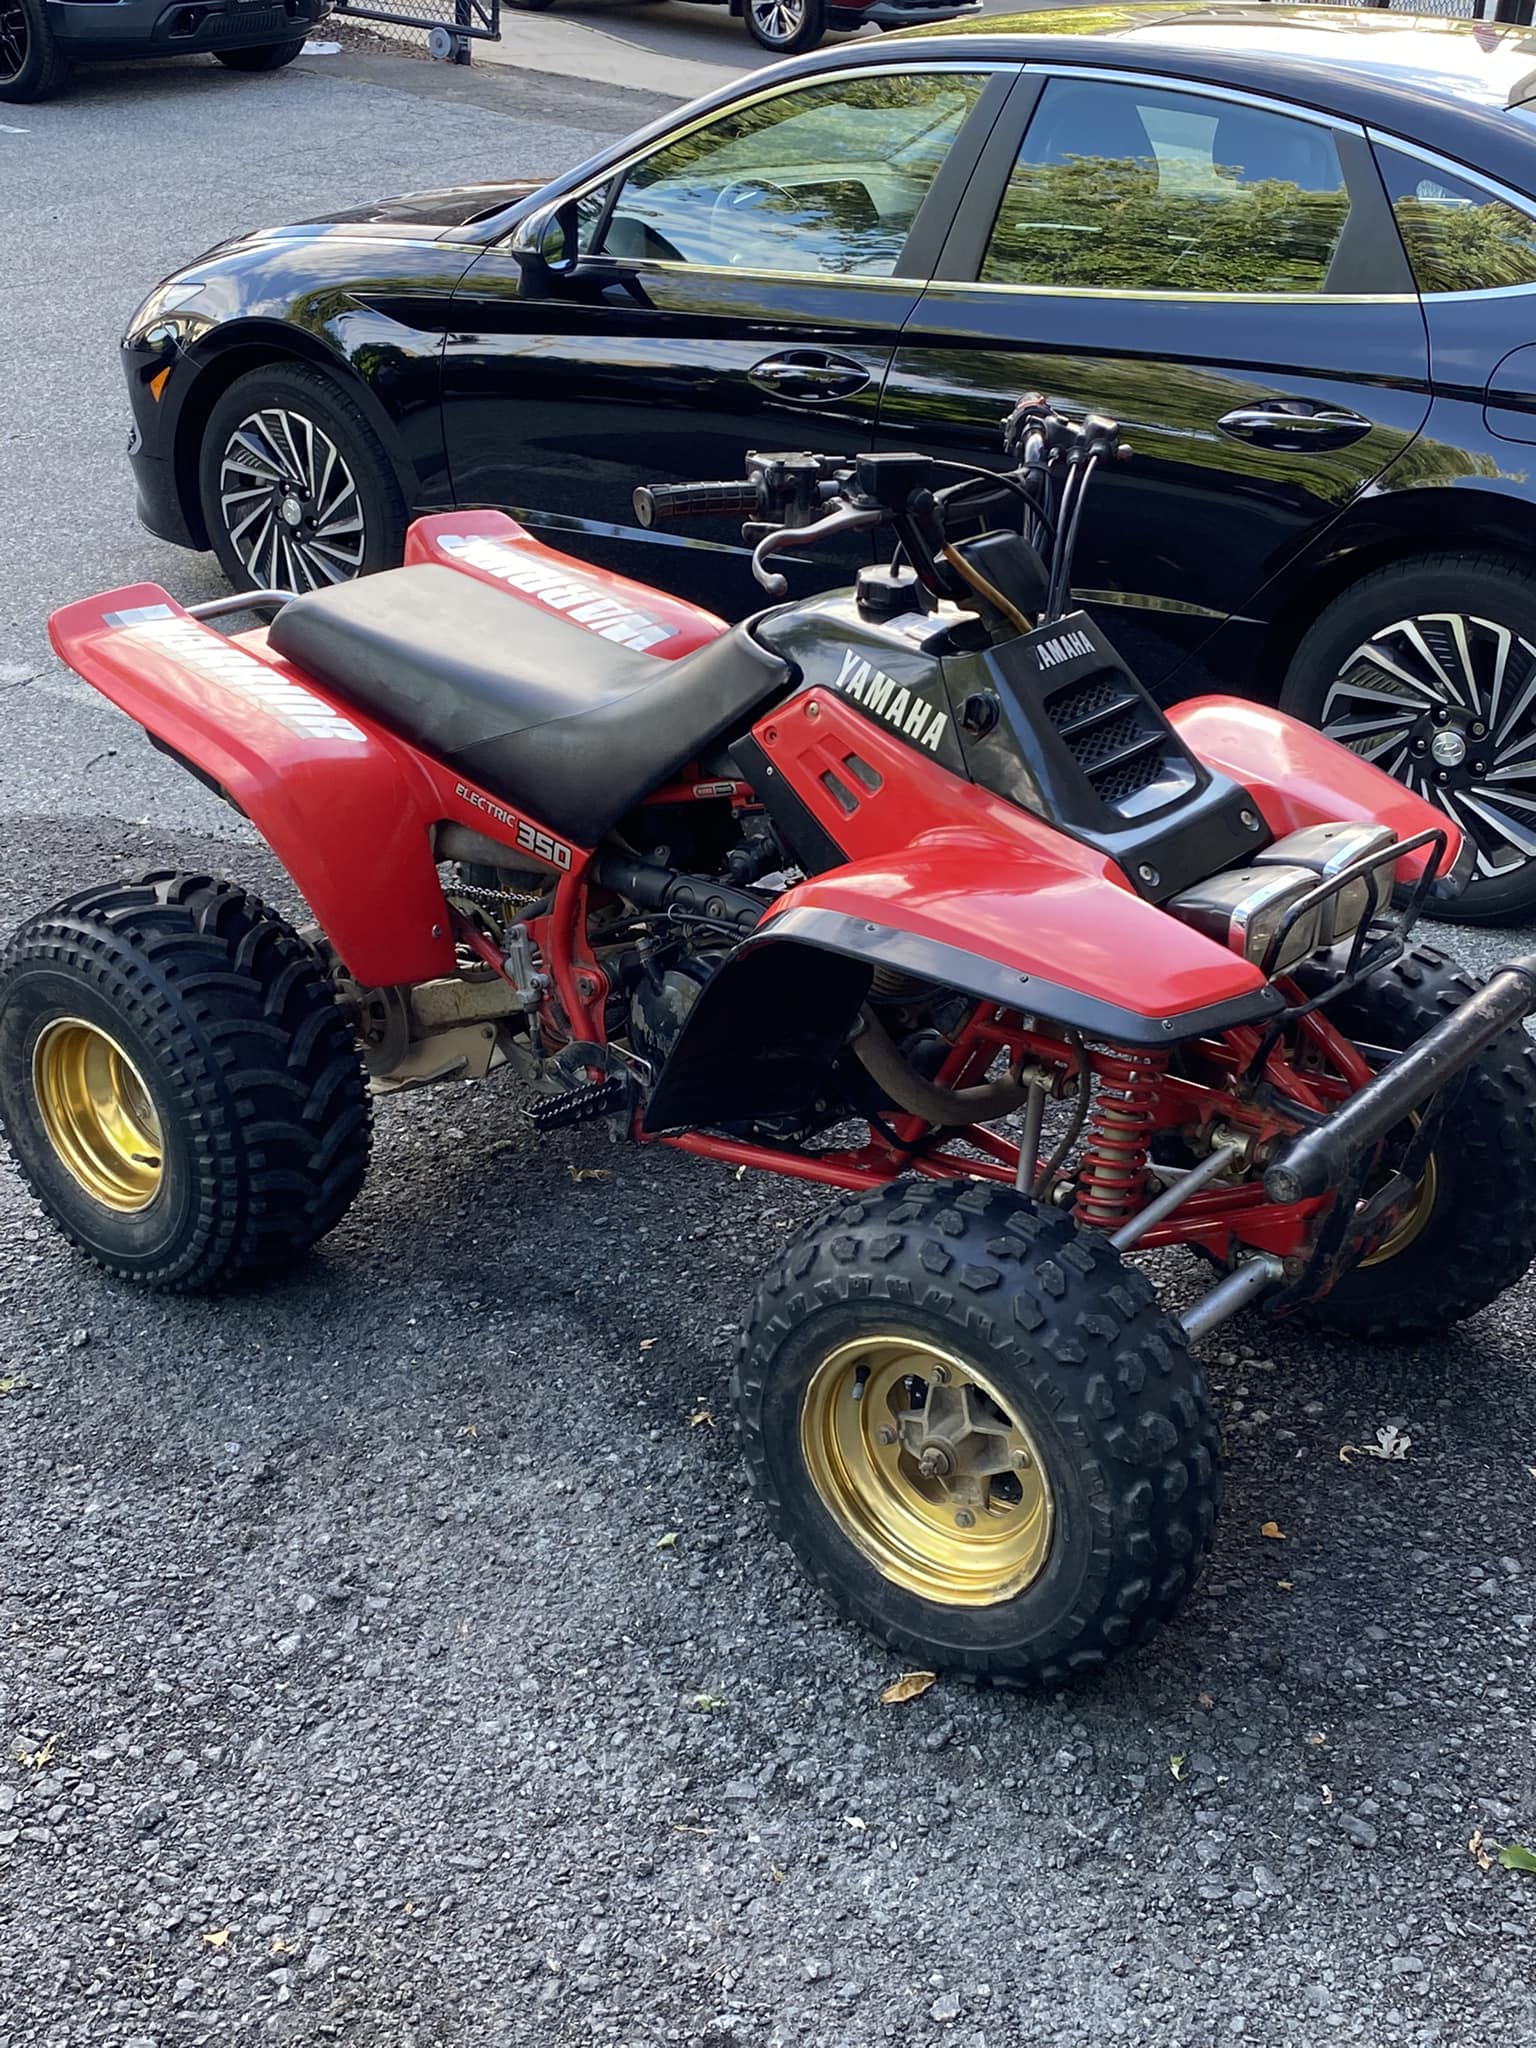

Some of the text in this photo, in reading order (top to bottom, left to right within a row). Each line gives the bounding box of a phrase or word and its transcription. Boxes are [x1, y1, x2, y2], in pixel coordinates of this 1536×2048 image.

[835, 648, 949, 752] YAMAHA
[455, 783, 572, 872] ELECTRIC 350
